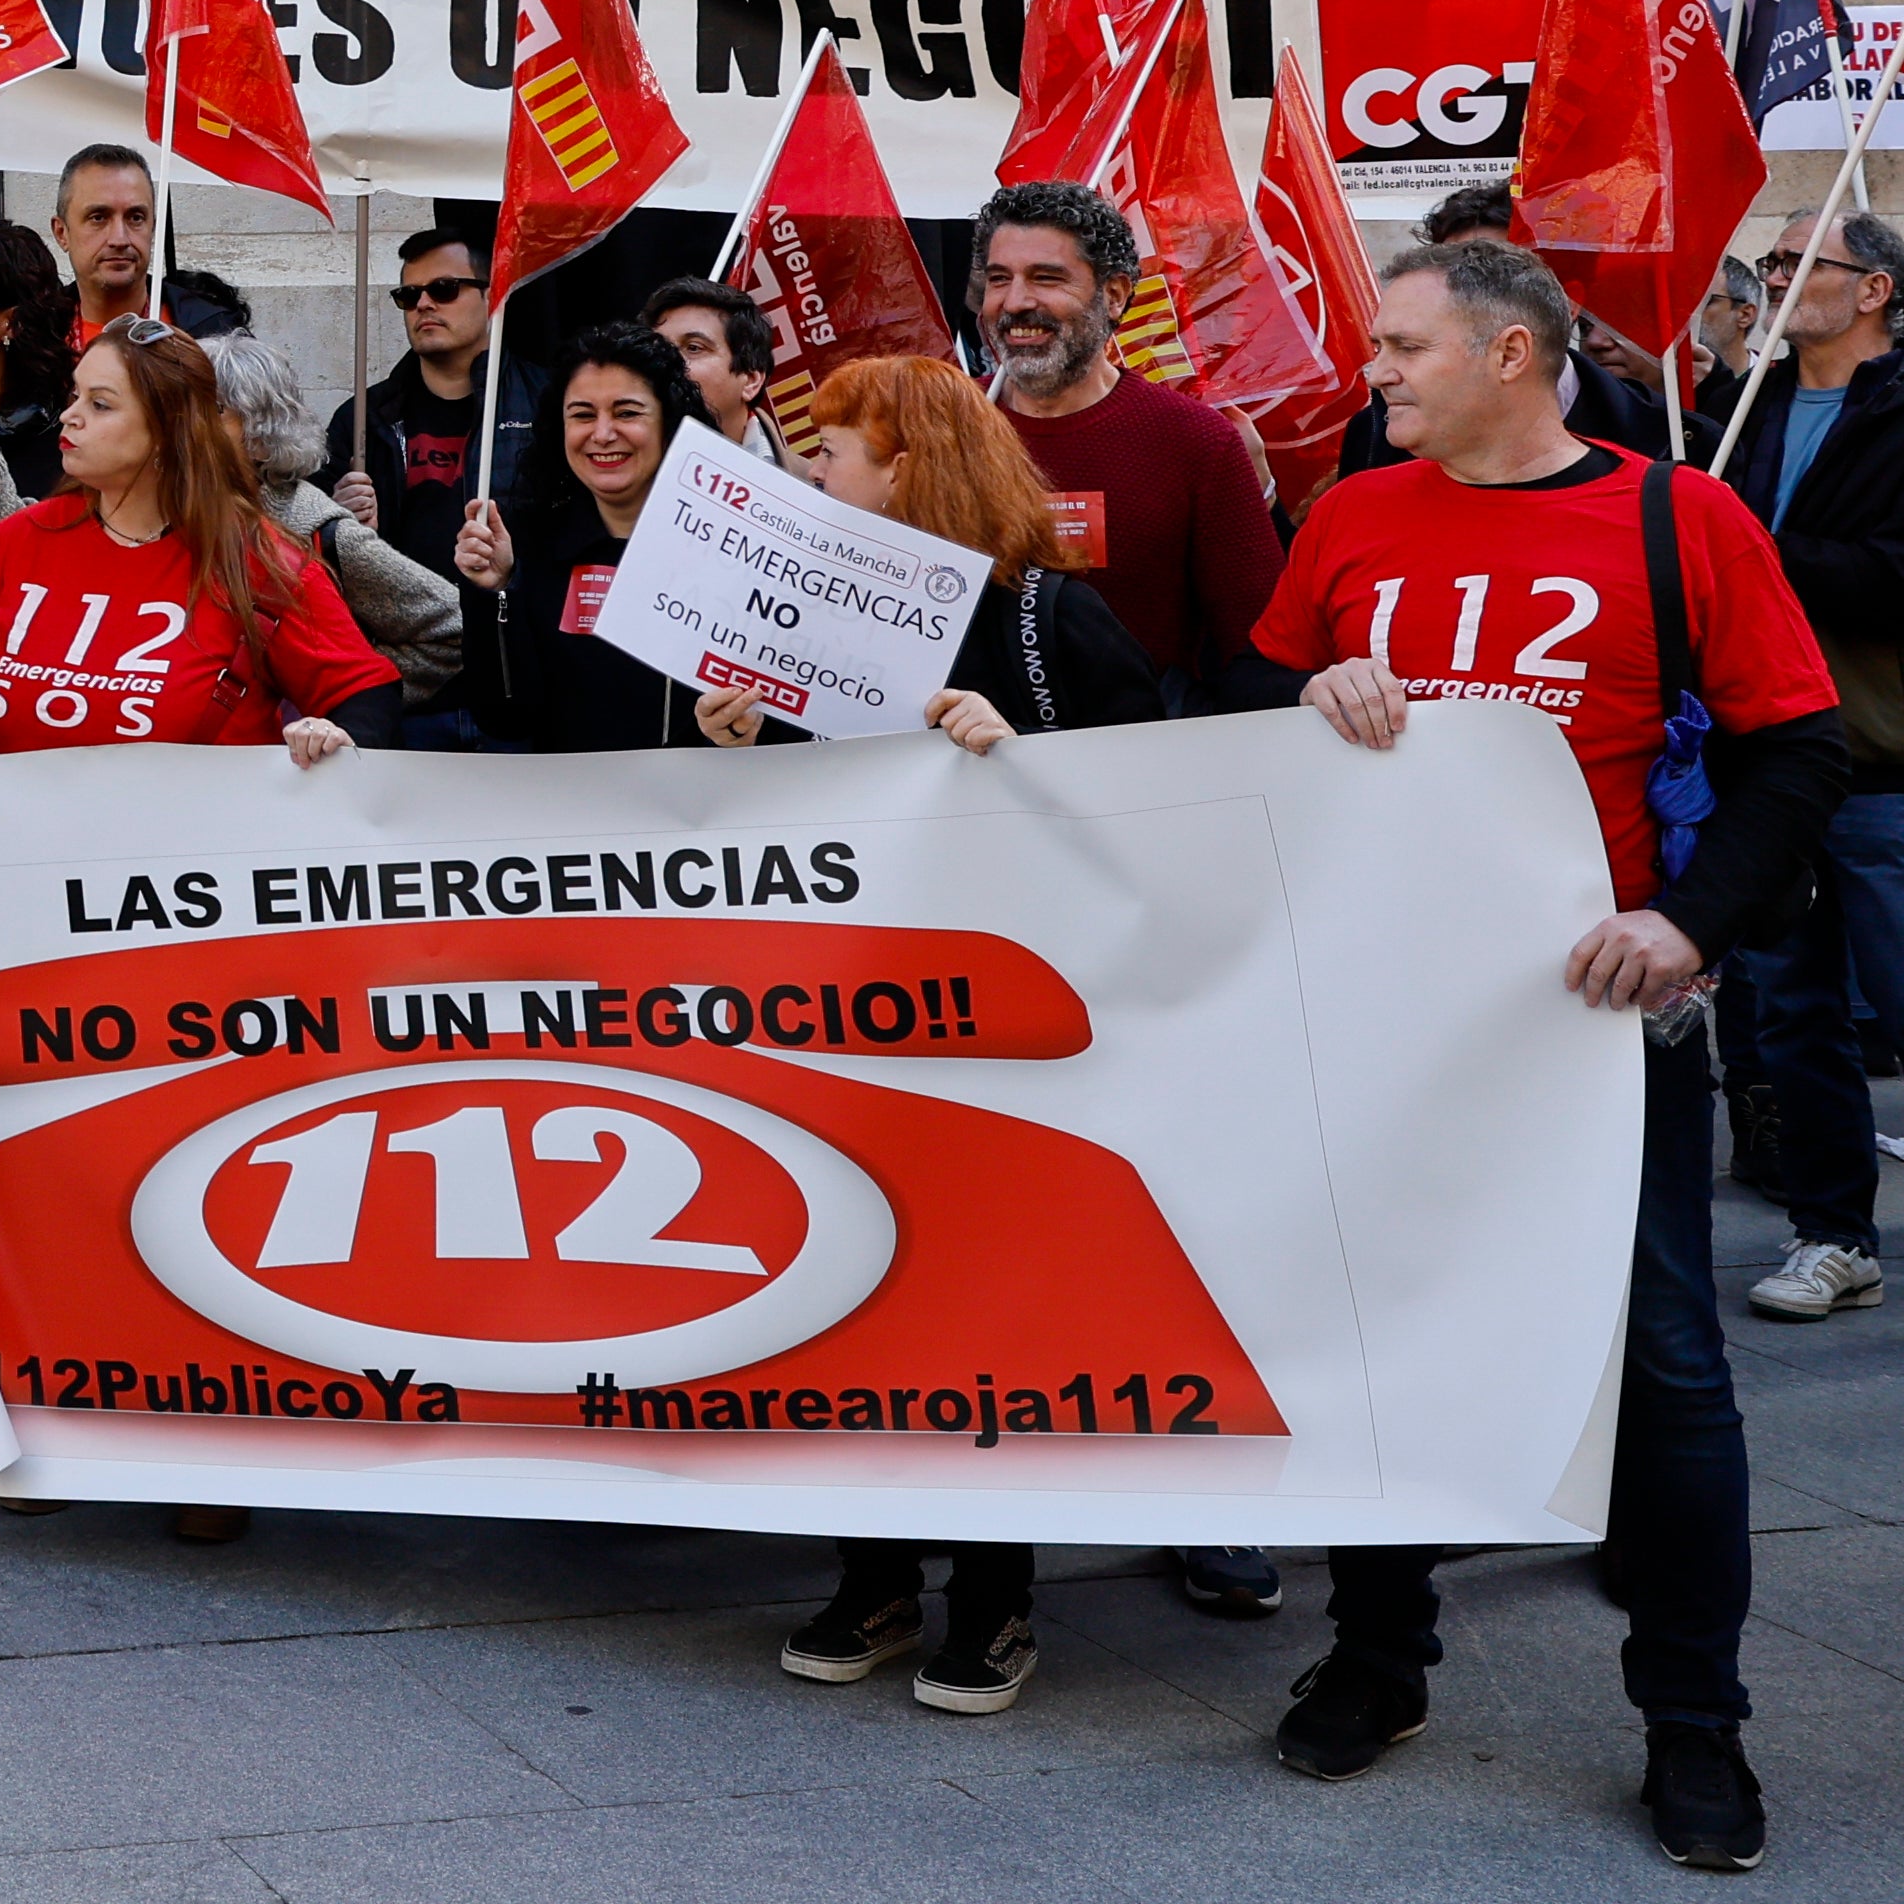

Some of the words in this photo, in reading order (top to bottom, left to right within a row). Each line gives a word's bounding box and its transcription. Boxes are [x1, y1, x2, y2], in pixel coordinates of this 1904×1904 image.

[1354, 167, 1369, 178] Cid,
[1370, 167, 1384, 177] 154
[1390, 166, 1413, 176] 46014
[1415, 163, 1452, 175] VALENCIA
[1458, 162, 1472, 174] Tel.
[671, 499, 714, 547] Tus
[718, 525, 950, 642] EMERGENCIAS
[709, 472, 752, 512] 112
[749, 501, 830, 554] Castilla-La
[833, 541, 908, 582] Mancha
[5, 582, 188, 675] 112
[652, 590, 703, 635] son
[710, 623, 749, 655] un
[756, 637, 887, 709] negocio
[745, 587, 802, 630] NO
[1369, 573, 1600, 681] 112
[62, 868, 224, 936] LAS
[251, 838, 864, 924] EMERGENCIAS
[18, 1003, 138, 1067] NO
[164, 993, 344, 1061] SON
[369, 987, 491, 1055] UN
[518, 975, 978, 1058] NEGOCIO!!
[247, 1104, 771, 1278] 112
[576, 1370, 1220, 1449] #marearoja112
